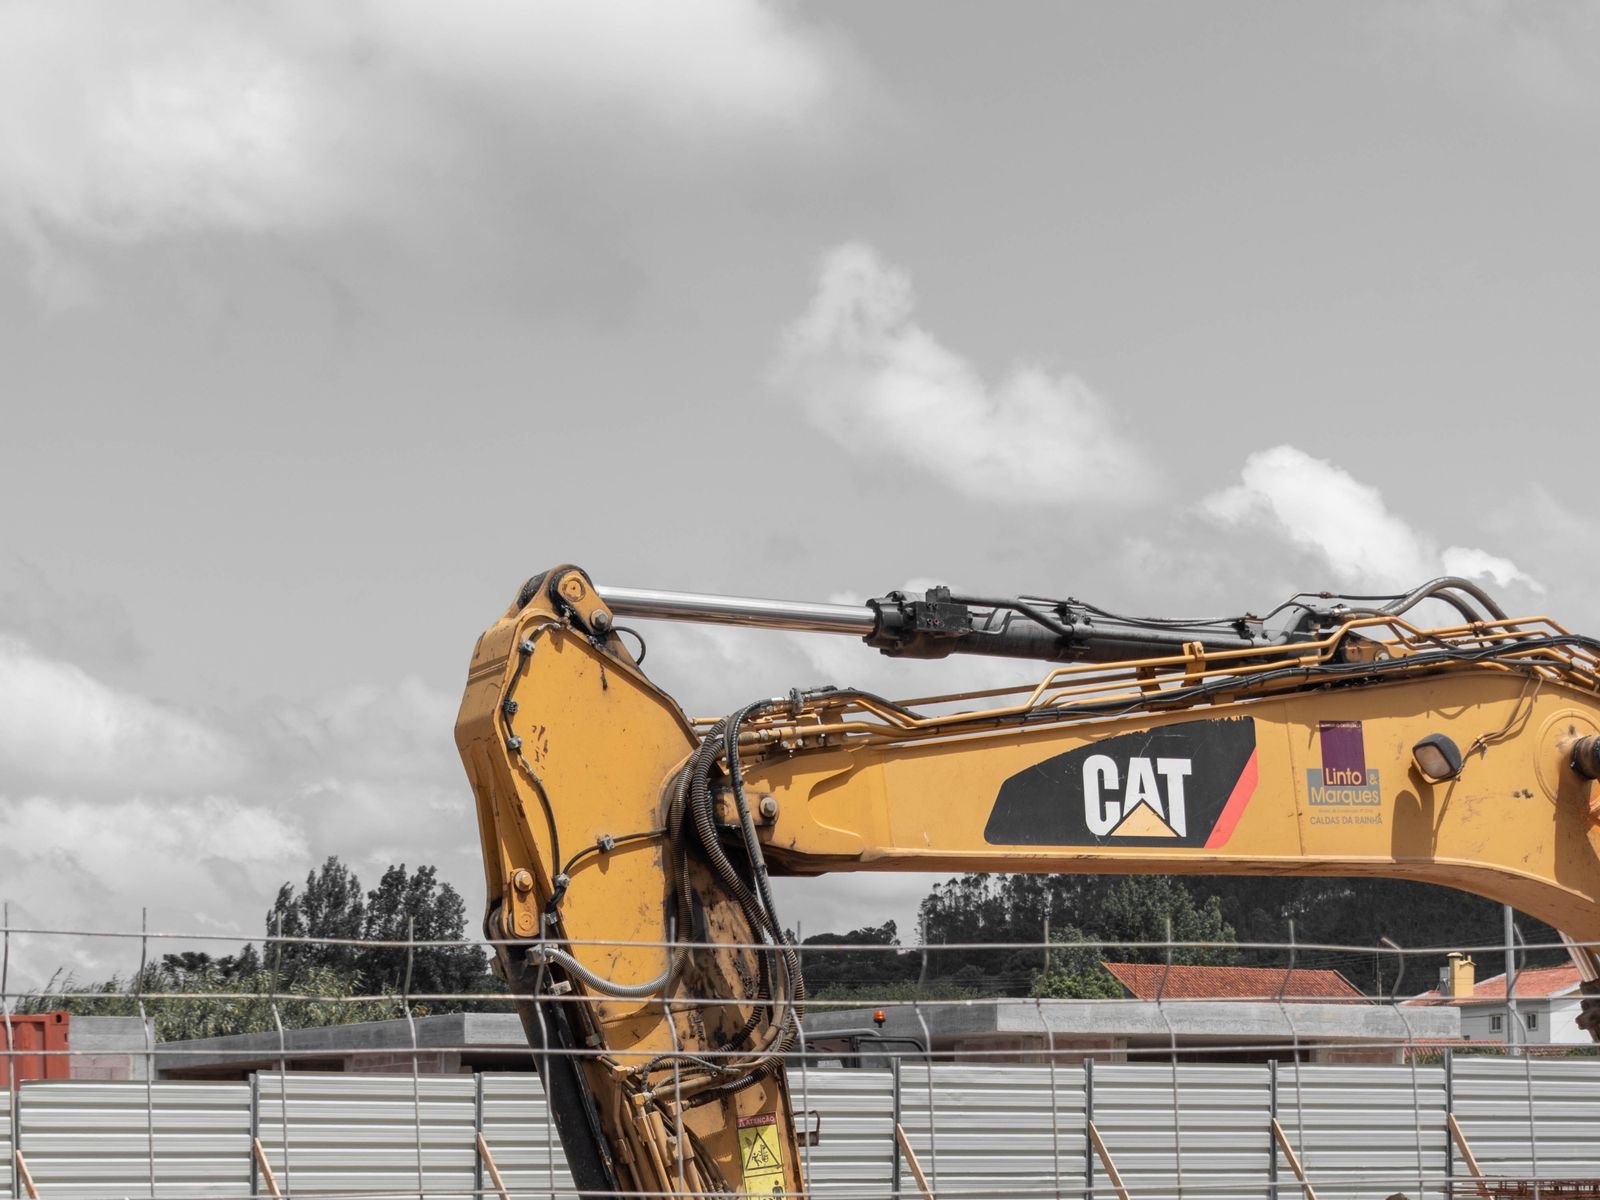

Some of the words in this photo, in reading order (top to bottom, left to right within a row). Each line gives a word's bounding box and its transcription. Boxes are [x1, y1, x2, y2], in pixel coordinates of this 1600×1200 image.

[1325, 767, 1362, 785] Linto
[1368, 773, 1379, 785] &
[1082, 754, 1193, 838] CAT
[1310, 786, 1379, 806] Marques
[1309, 816, 1340, 825] CALDAS
[1341, 816, 1353, 825] DA
